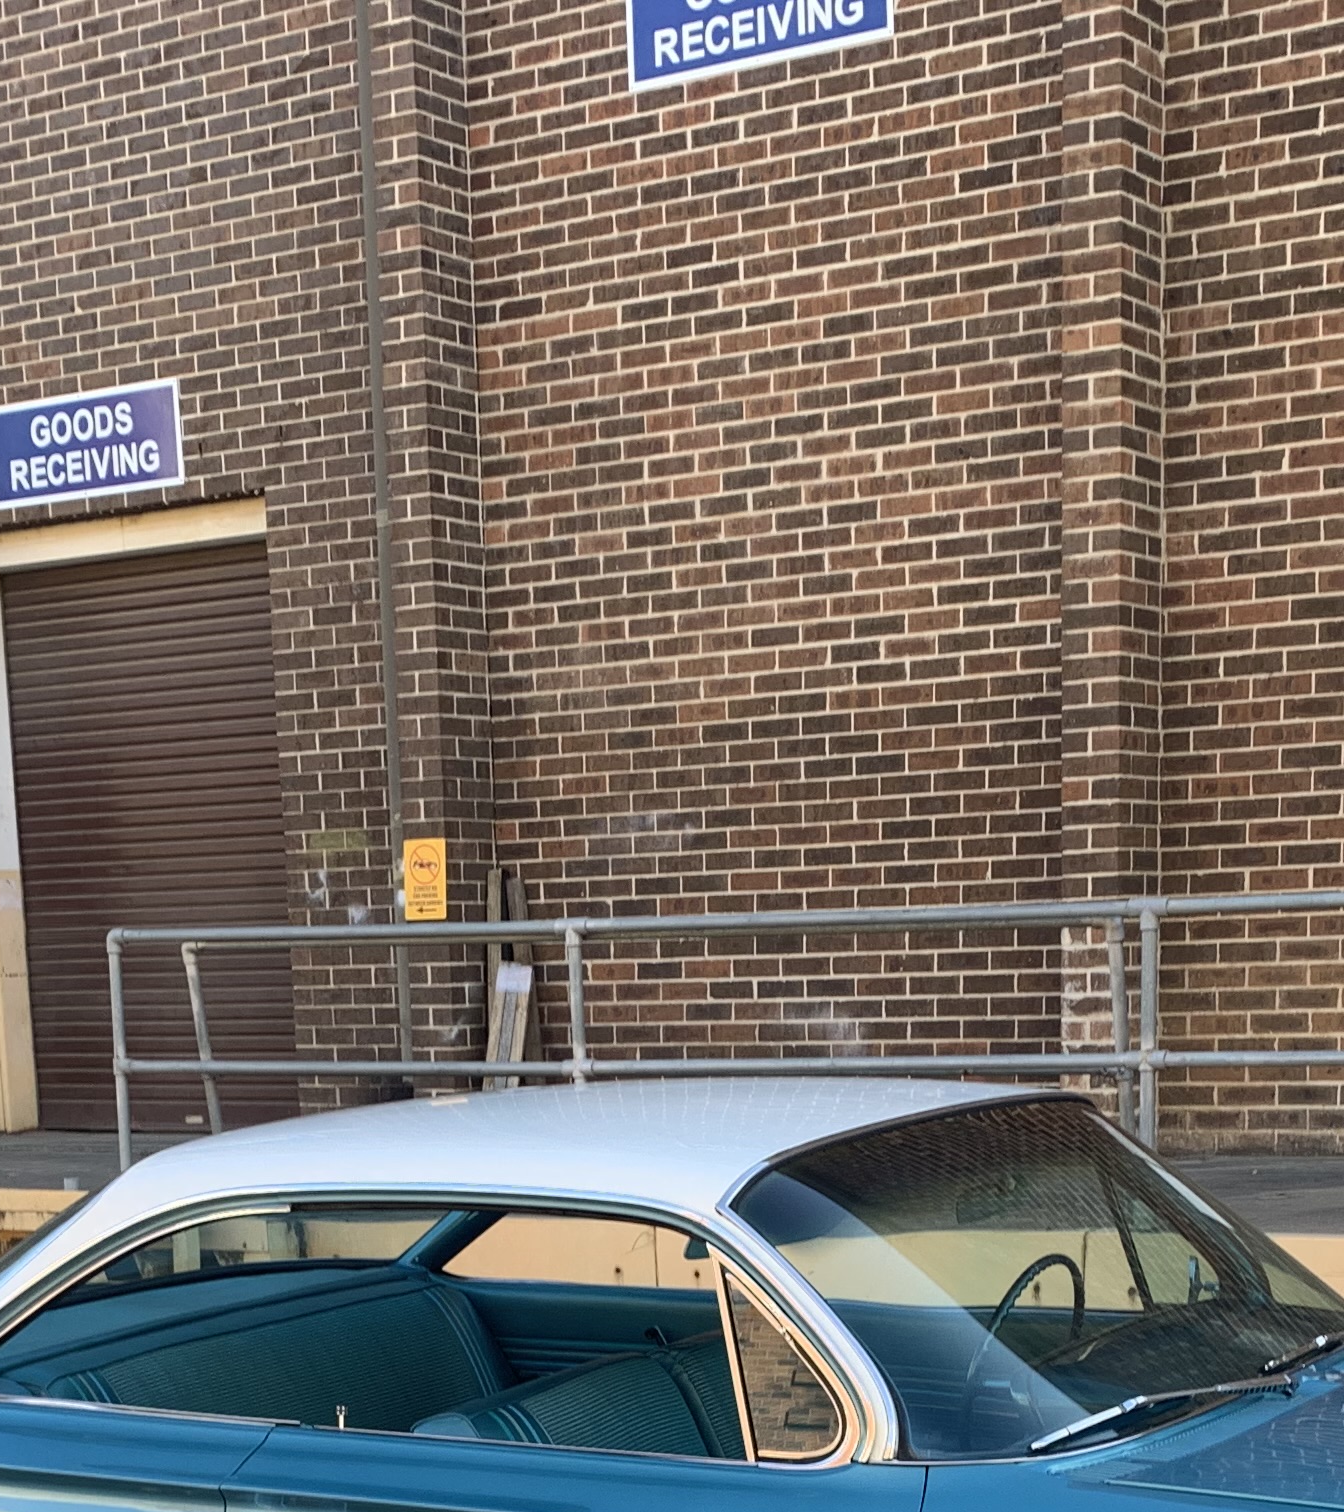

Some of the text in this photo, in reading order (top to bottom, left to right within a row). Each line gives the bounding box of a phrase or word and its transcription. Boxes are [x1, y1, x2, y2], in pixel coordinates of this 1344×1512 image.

[654, 0, 864, 67] RECEIVING
[30, 401, 133, 448] GOODS
[10, 439, 160, 492] RECEIVING
